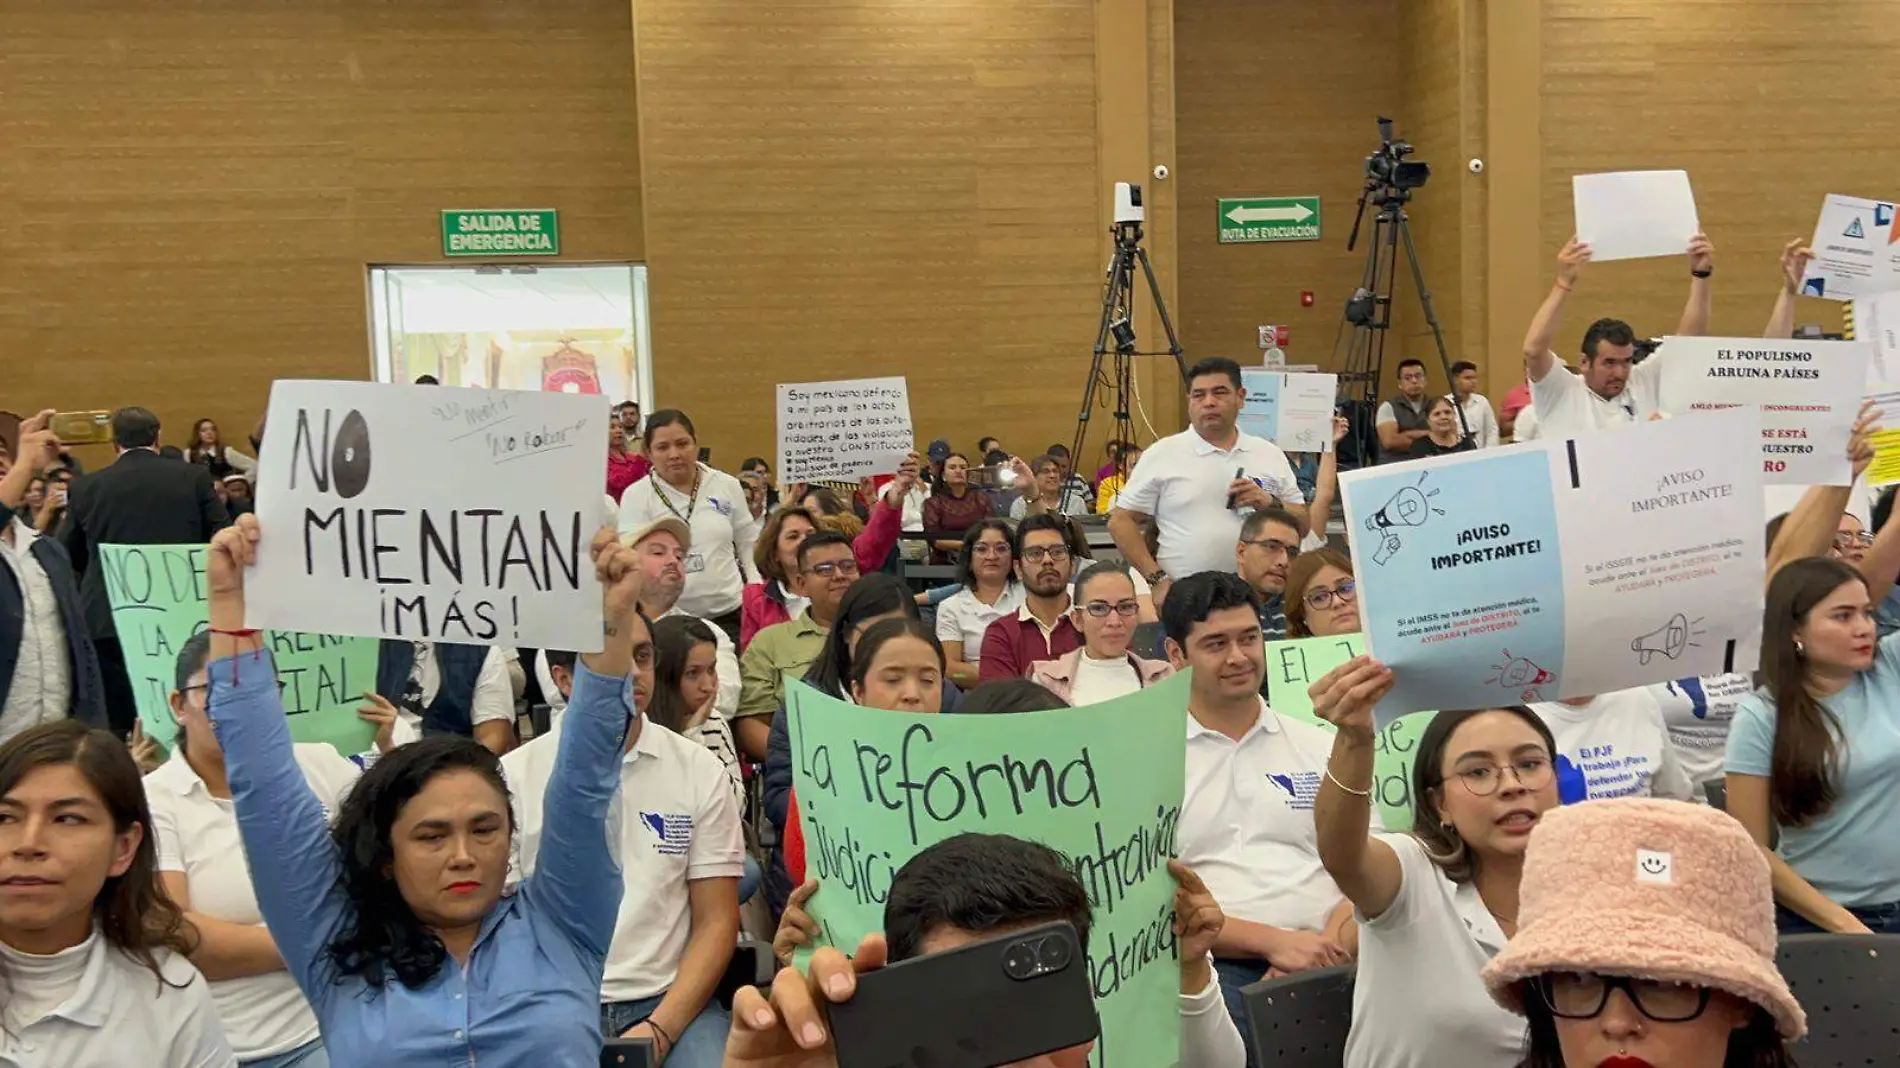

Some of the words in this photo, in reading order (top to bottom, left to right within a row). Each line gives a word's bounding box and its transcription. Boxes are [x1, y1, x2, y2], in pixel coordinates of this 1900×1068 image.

[458, 215, 517, 231] SALIDA
[518, 215, 542, 231] DE
[1222, 227, 1246, 240] RUTA
[1247, 227, 1260, 238] DE
[1261, 222, 1319, 238] EVACUACIÓN
[449, 233, 552, 250] EMERGENCIA
[1717, 350, 1735, 360] EL
[1737, 350, 1813, 362] POPULISMO
[1707, 367, 1771, 378] ARRUINA
[1773, 366, 1820, 379] PAÍSES
[1777, 428, 1808, 438] ESTÁ
[289, 408, 372, 499] NO
[1656, 469, 1705, 493] ¡AVISO
[1631, 483, 1732, 513] IMPORTANTE!
[1456, 523, 1511, 546] ¡AVISO
[304, 506, 581, 592] MIENTAN
[1430, 538, 1541, 570] IMPORTANTE!
[95, 548, 153, 604] NO
[1416, 613, 1440, 624] IMSS
[139, 622, 174, 657] LA
[793, 690, 838, 798] La
[852, 723, 1101, 846] reforma
